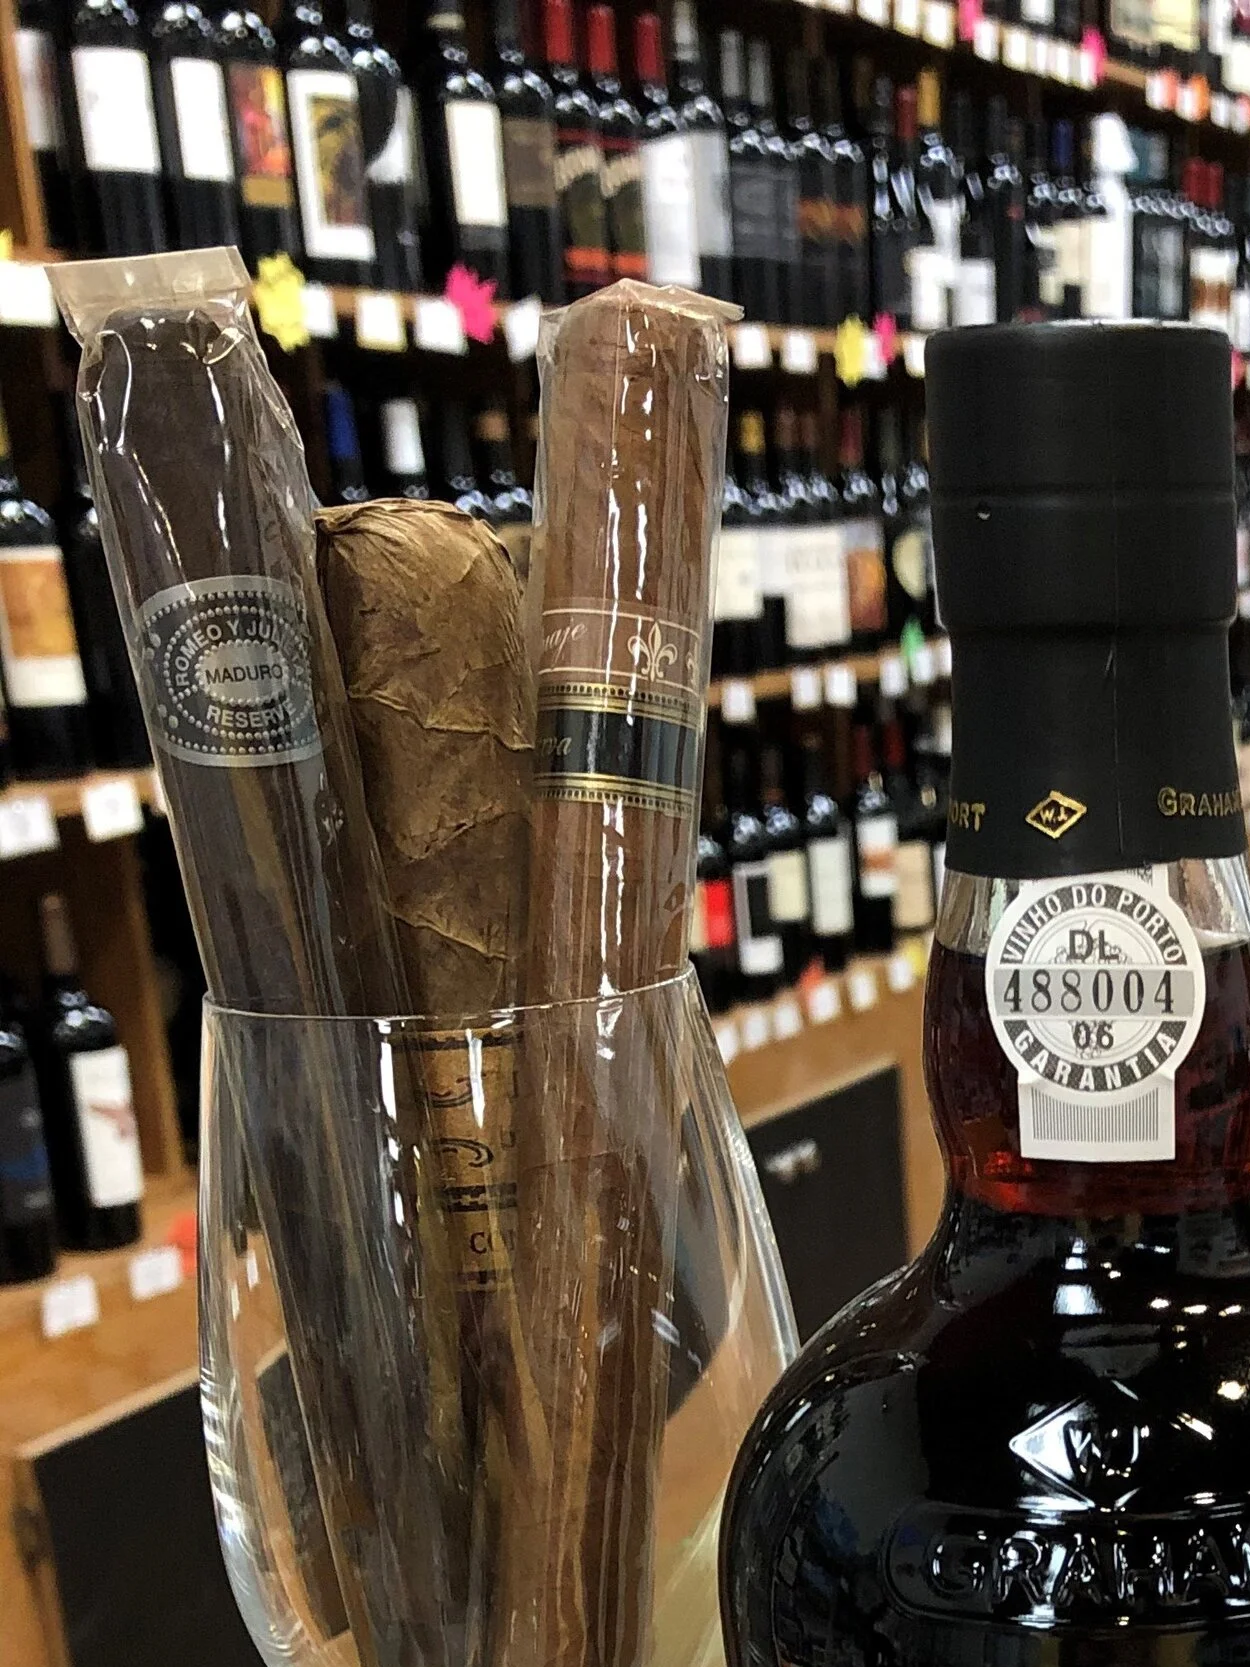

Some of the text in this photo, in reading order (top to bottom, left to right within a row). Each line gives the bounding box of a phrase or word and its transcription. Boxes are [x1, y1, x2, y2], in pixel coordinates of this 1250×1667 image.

[174, 623, 222, 687] ROMEO
[226, 618, 240, 636] Y
[204, 663, 284, 685] MADURO
[206, 699, 297, 729] RESERVE
[1002, 884, 1183, 963] VINHO DO PORTO
[1066, 928, 1120, 961] DL
[1003, 968, 1175, 1014] 488004
[1072, 1021, 1115, 1050] 06
[1013, 1029, 1178, 1092] GARANTIA
